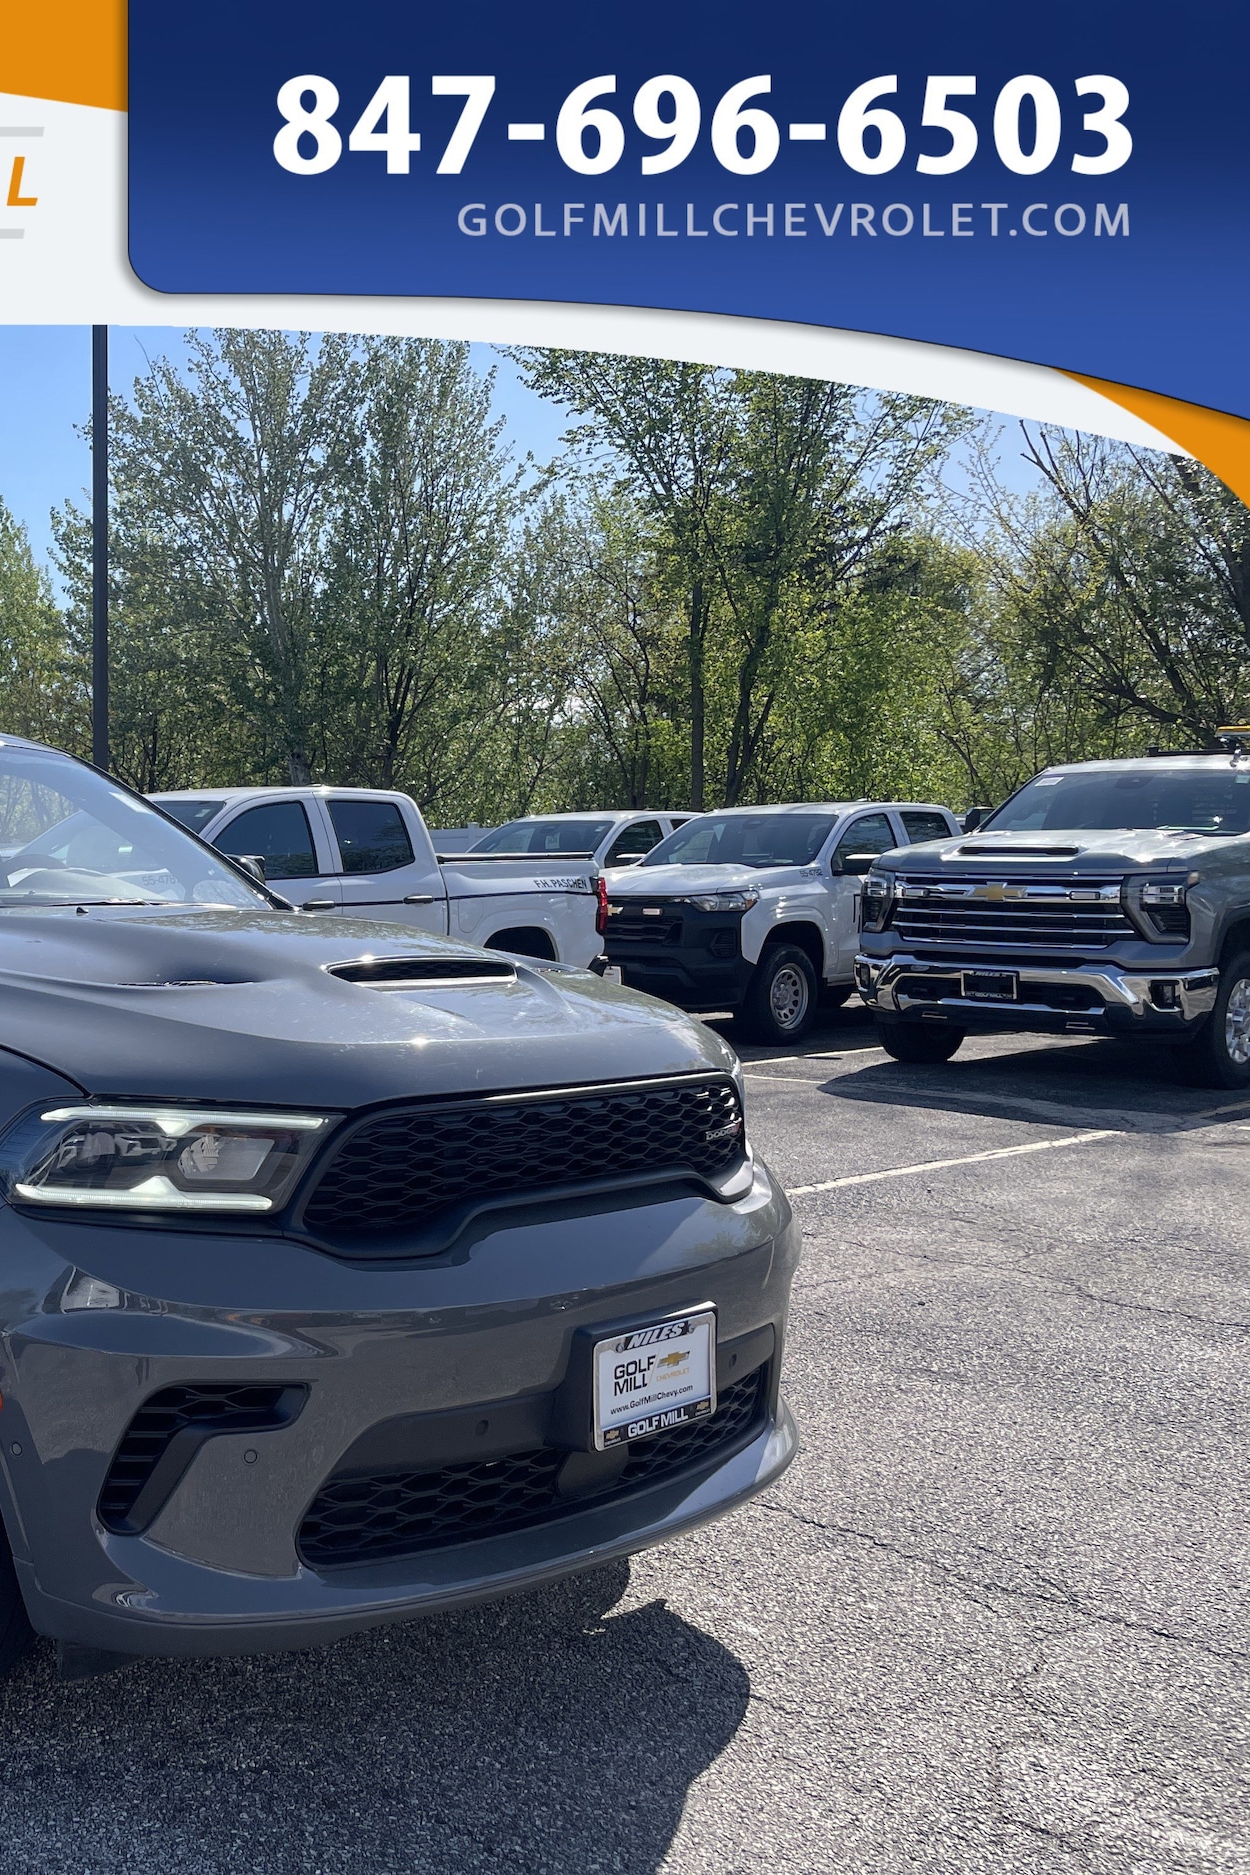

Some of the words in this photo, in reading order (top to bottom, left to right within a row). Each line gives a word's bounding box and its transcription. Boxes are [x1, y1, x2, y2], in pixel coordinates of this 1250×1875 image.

[552, 879, 588, 889] PASCHEN
[626, 1322, 685, 1349] NILES
[614, 1354, 656, 1380] GOLF
[613, 1374, 648, 1396] MILL
[610, 1384, 693, 1415] www.GolfMillChevy.com
[627, 1415, 660, 1438] GOLF
[660, 1408, 688, 1427] MILL
